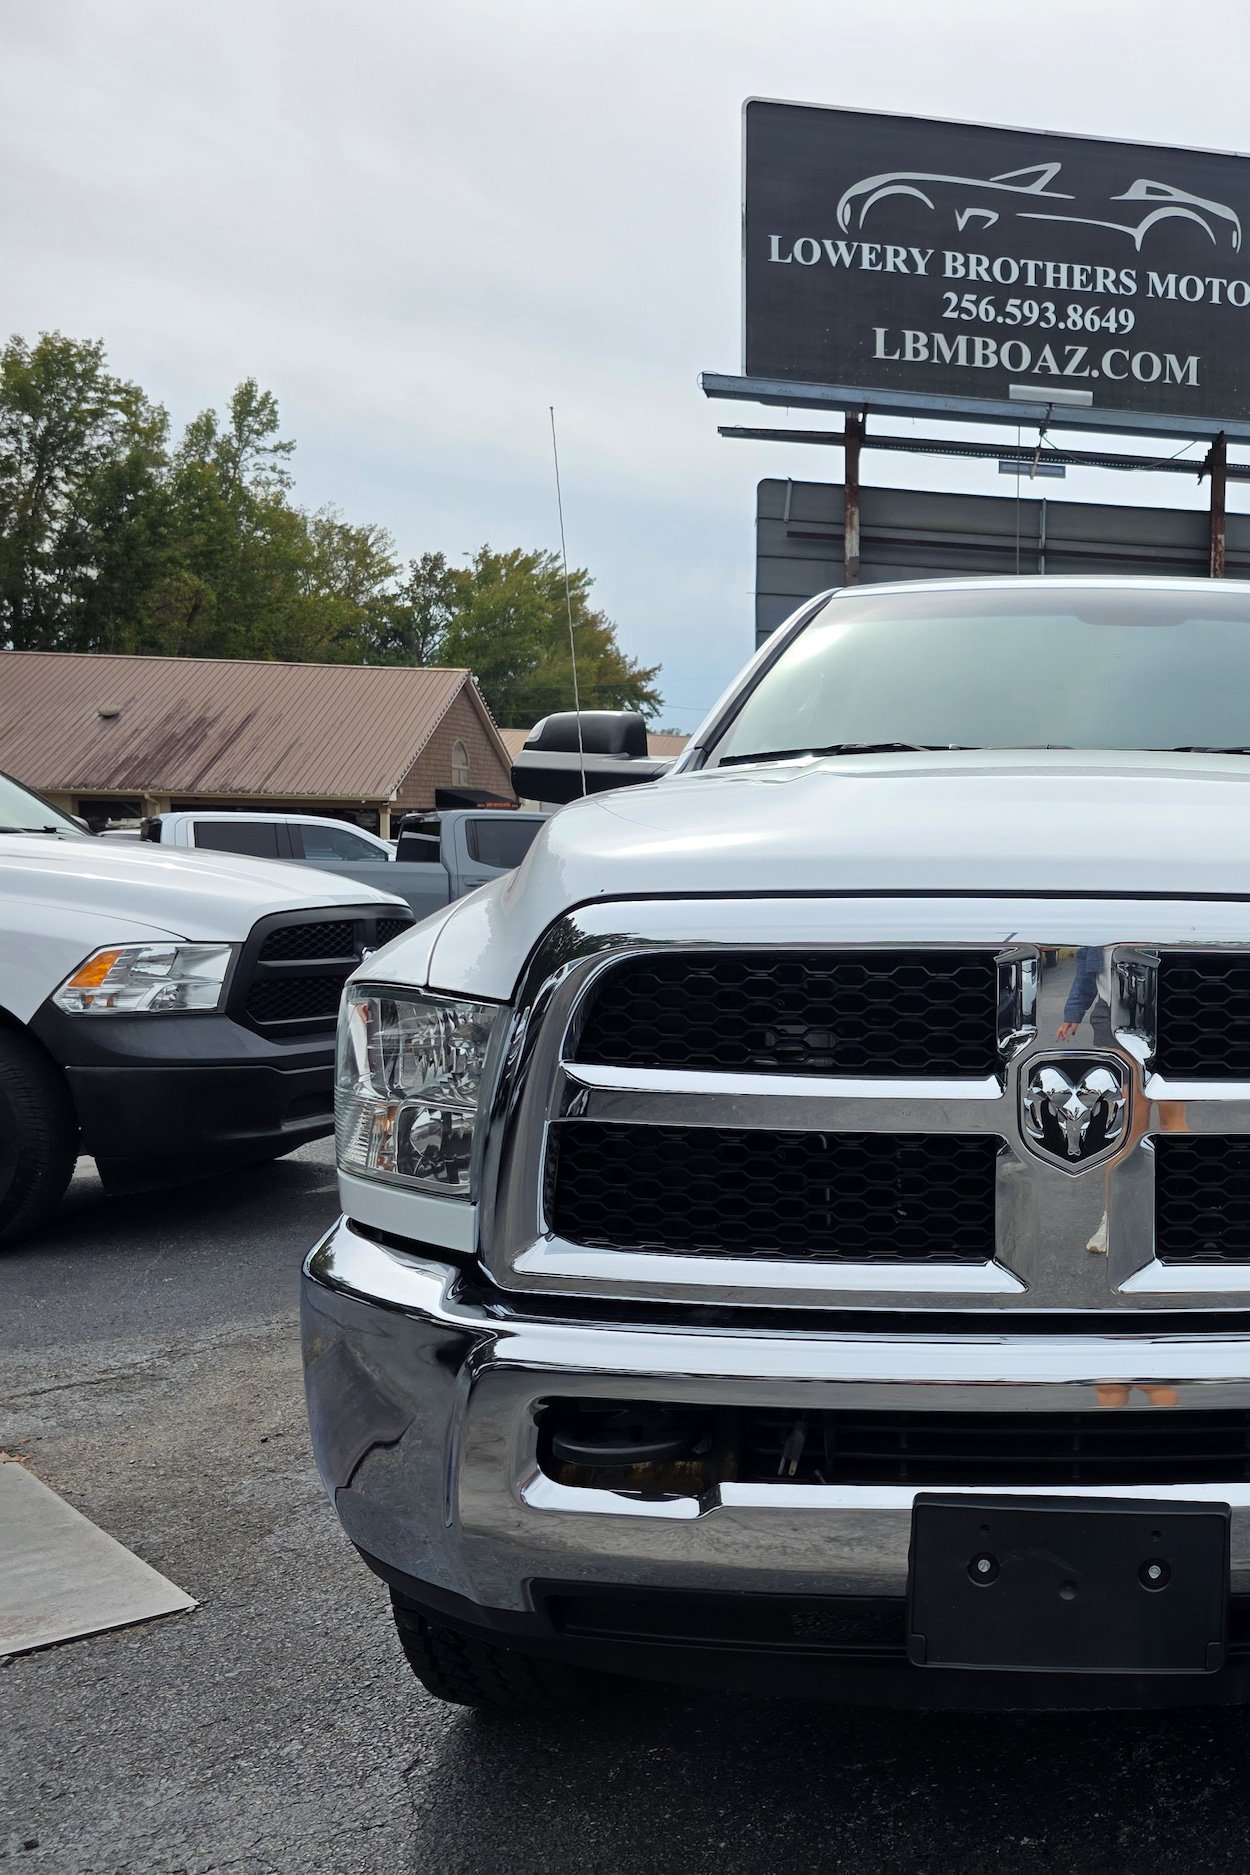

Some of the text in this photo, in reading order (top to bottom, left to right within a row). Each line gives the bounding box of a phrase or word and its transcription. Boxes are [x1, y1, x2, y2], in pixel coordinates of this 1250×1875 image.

[767, 235, 935, 276] LOWERY
[941, 251, 1138, 297] BROTHERS
[941, 291, 1136, 335] 256.593.8649
[872, 327, 1201, 387] LBMBOAZ.COM
